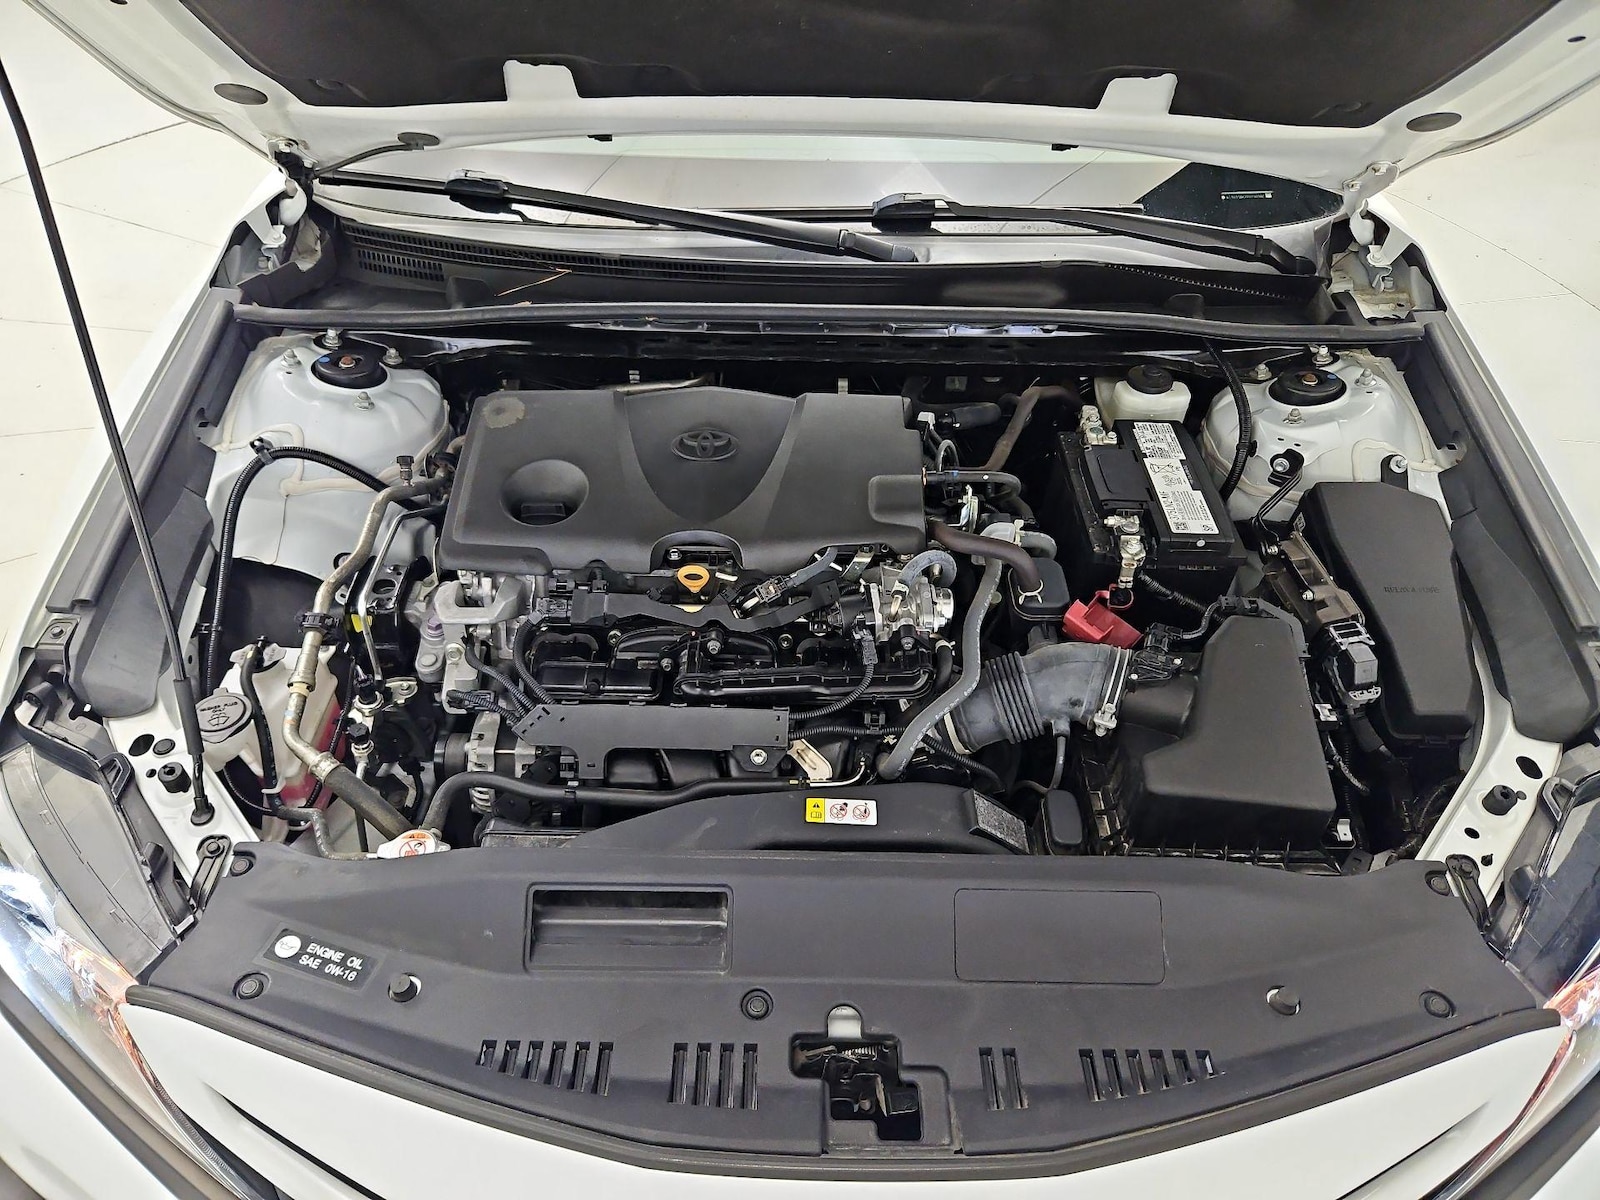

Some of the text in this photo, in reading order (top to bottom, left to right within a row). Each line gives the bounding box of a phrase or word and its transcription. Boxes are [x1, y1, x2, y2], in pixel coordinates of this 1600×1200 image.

[299, 954, 357, 981] SAE 0W-16
[306, 942, 364, 970] ENGINE OIL
